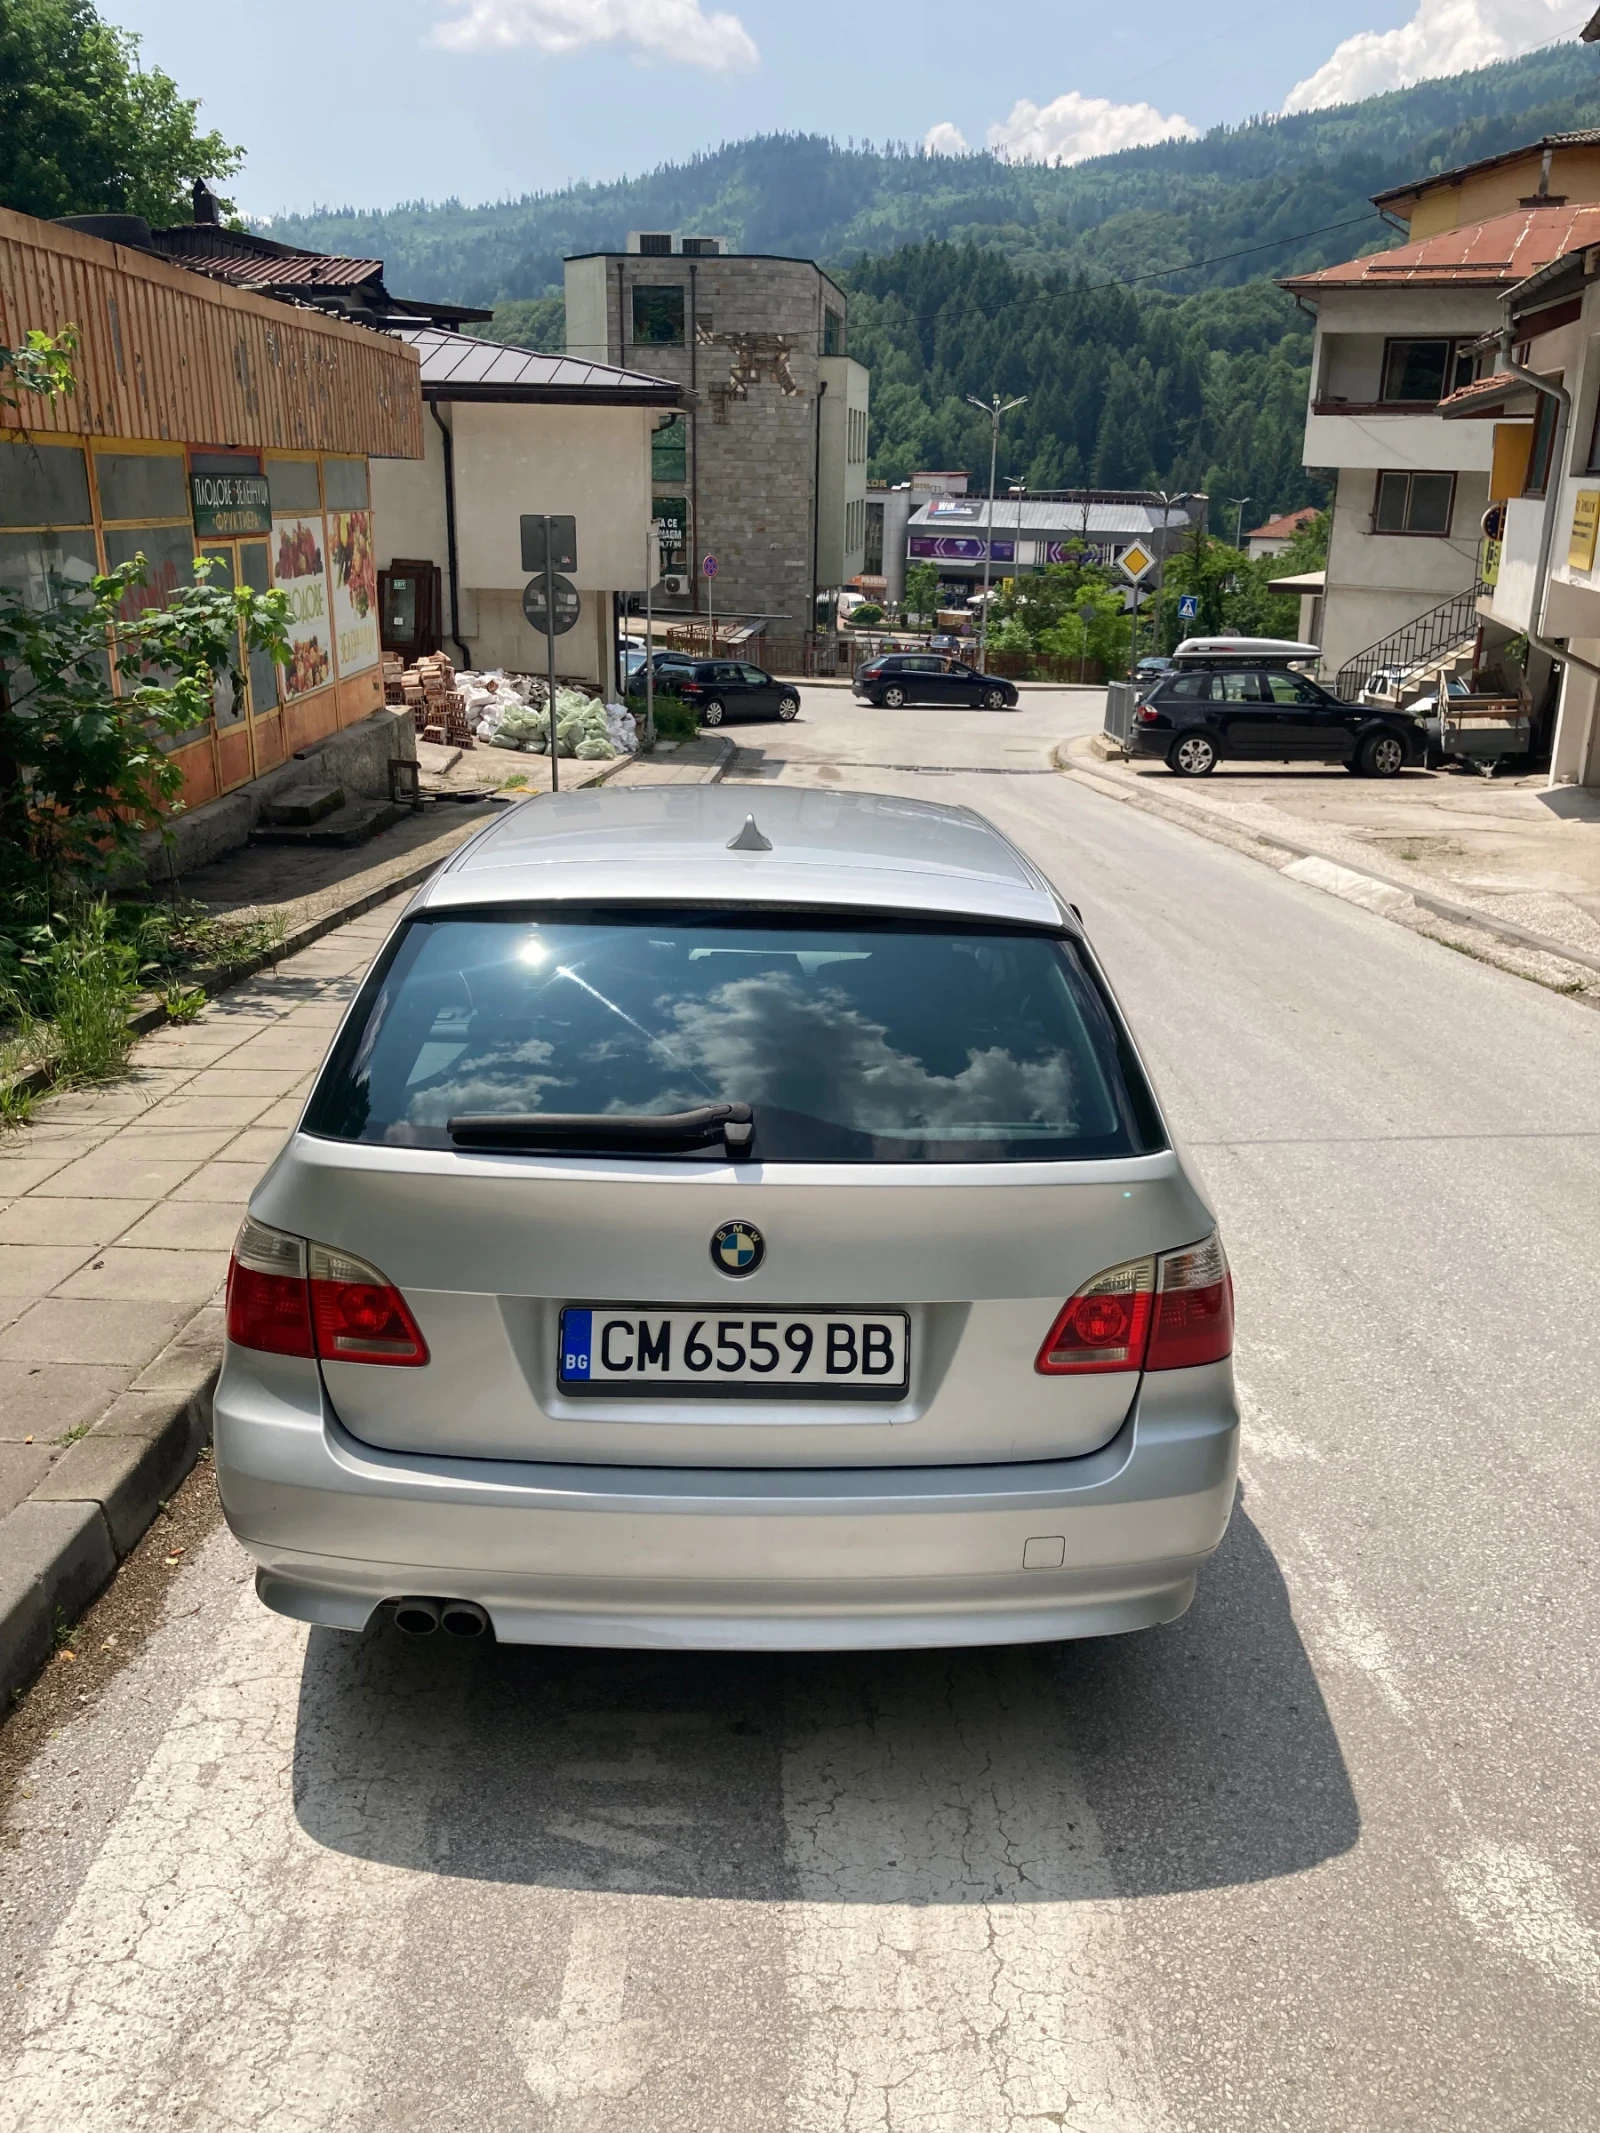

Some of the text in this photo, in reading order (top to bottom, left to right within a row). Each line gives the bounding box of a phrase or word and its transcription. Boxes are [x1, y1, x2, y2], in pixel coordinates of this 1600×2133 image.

[716, 1224, 761, 1241] BMW
[601, 1320, 894, 1375] CM 6559 BB
[565, 1354, 588, 1370] BG
